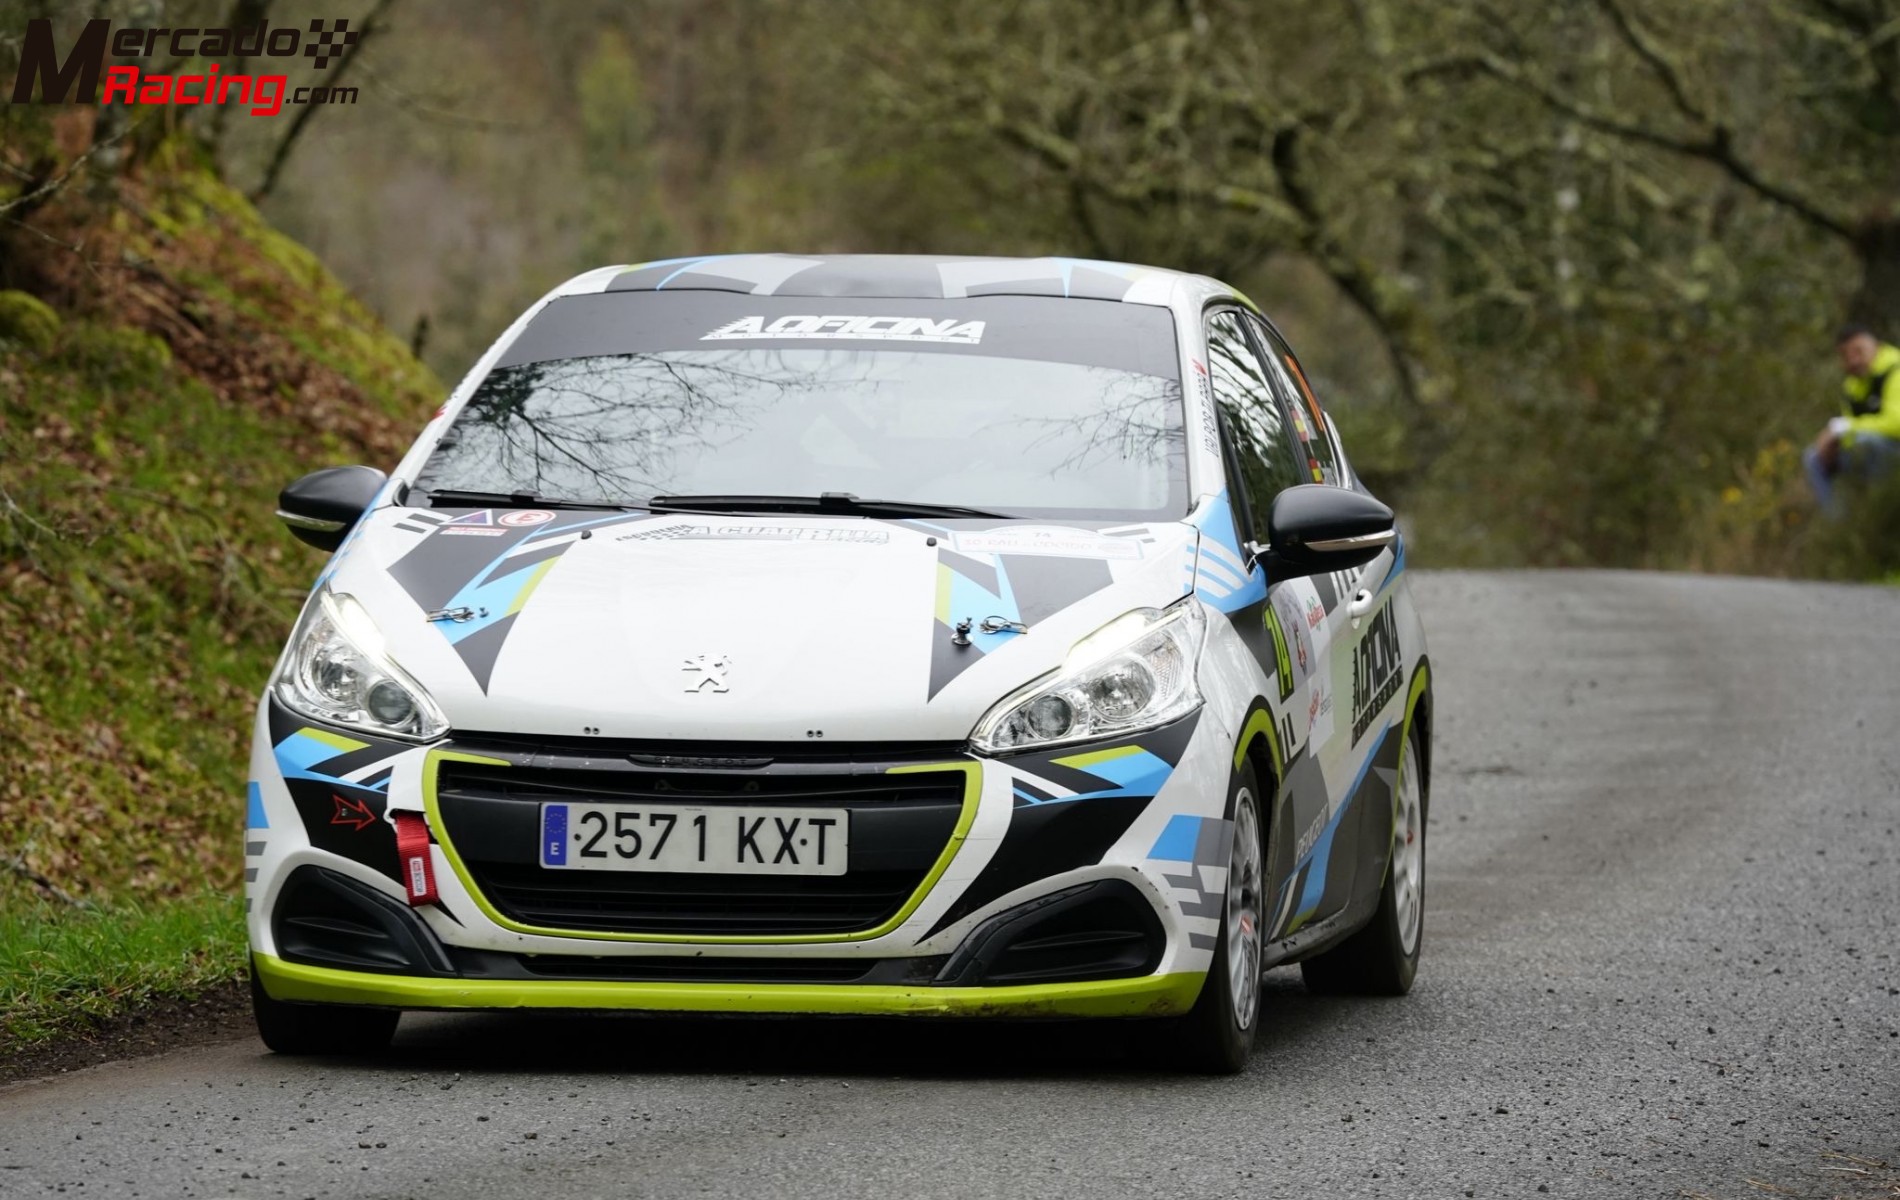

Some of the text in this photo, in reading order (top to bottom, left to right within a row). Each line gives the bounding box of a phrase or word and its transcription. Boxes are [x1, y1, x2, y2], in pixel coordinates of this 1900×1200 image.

[550, 842, 560, 856] E
[579, 811, 837, 865] 2571 KXT
